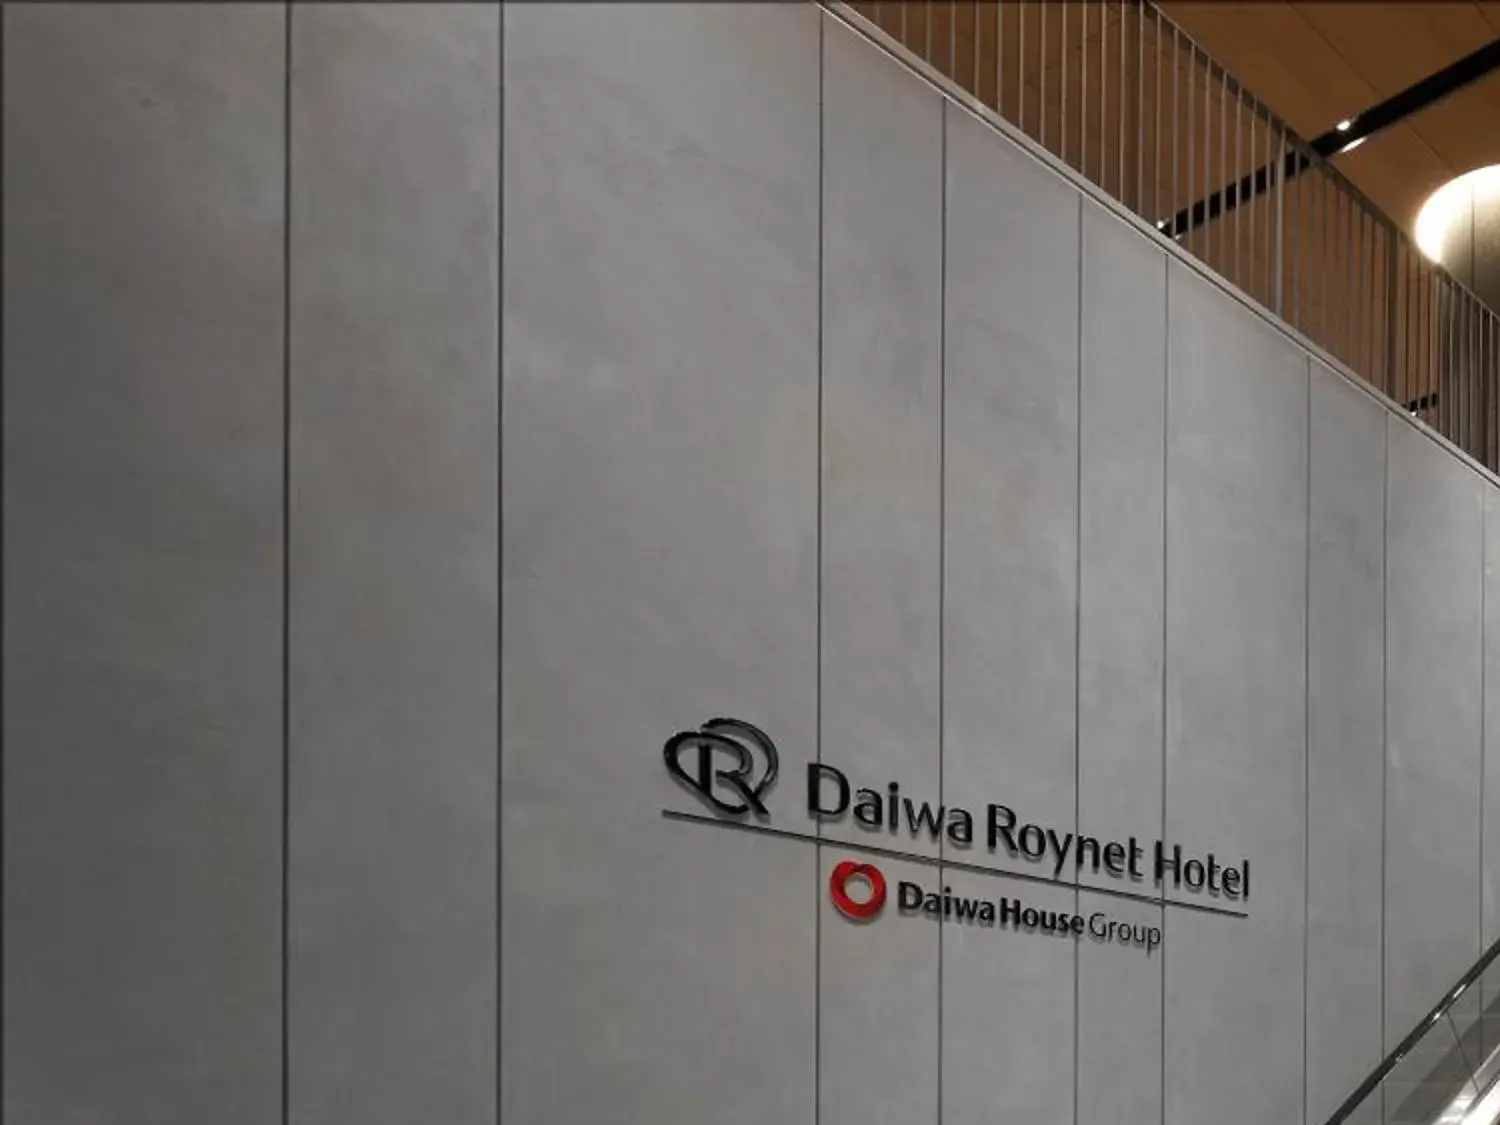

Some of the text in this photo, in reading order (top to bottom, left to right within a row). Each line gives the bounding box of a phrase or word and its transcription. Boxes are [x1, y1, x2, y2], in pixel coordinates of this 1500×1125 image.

[807, 762, 1249, 898] Daiwa Roynet Hotel
[898, 881, 1161, 952] Daiwa House Group
